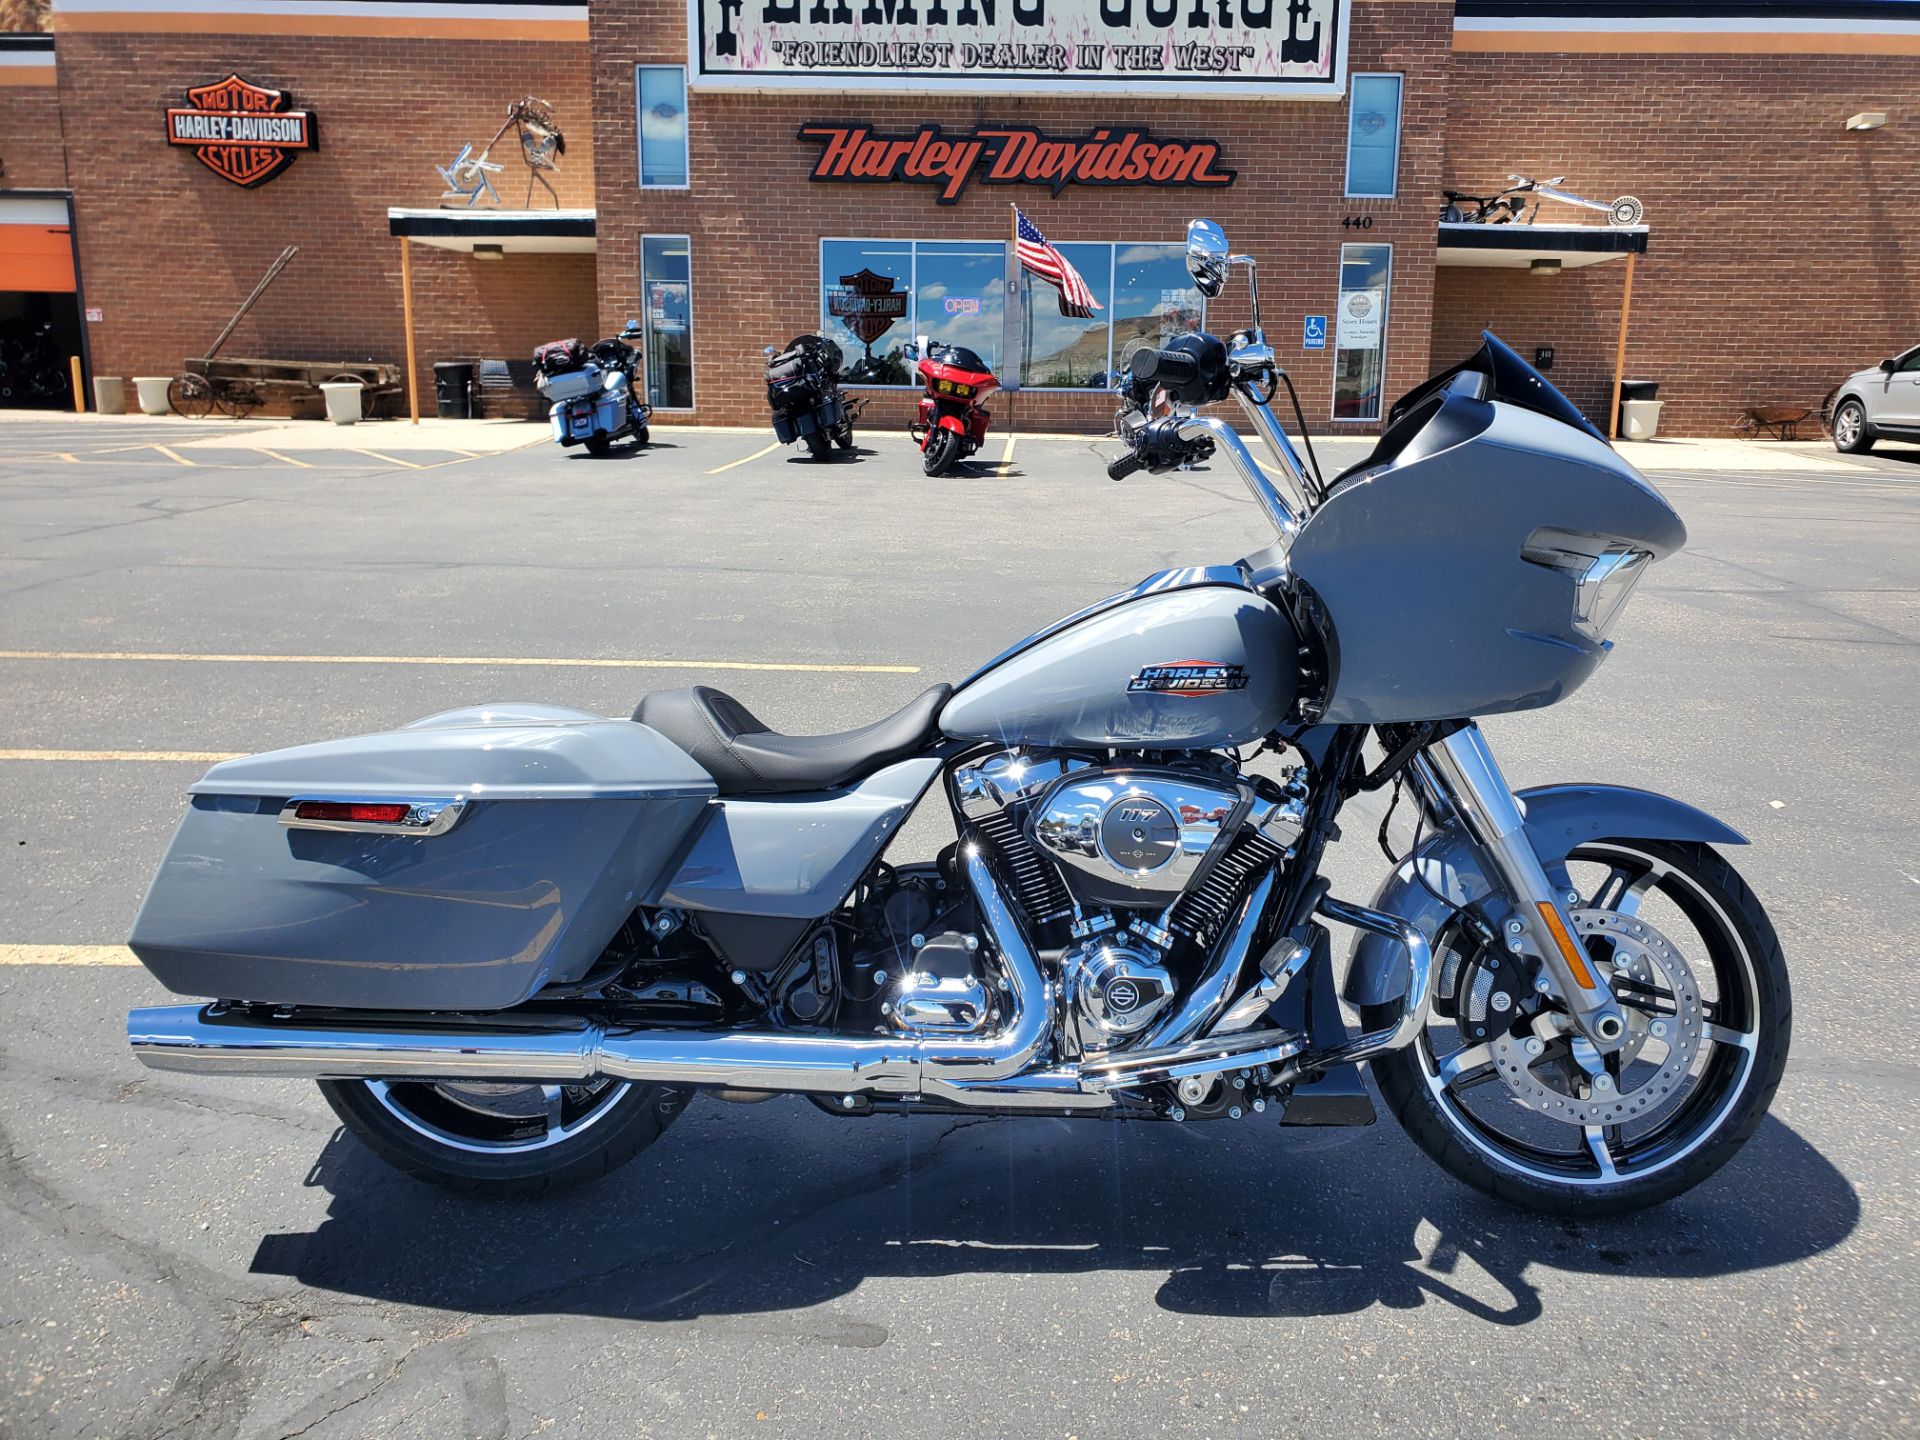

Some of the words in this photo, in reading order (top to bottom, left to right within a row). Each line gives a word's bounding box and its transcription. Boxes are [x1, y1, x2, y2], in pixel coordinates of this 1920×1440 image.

[962, 42, 1068, 72] DEALER
[1076, 44, 1104, 70] IN
[1112, 44, 1163, 71] THE
[202, 84, 270, 110] MOTOR
[174, 115, 302, 142] HARLEY-DAVIDSON
[206, 146, 273, 178] CYCLES
[803, 129, 1230, 198] Harley-Davidson
[1341, 216, 1373, 229] 440
[945, 299, 979, 313] OPEN
[1131, 678, 1247, 689] DAVIDSON
[1119, 808, 1161, 822] 117
